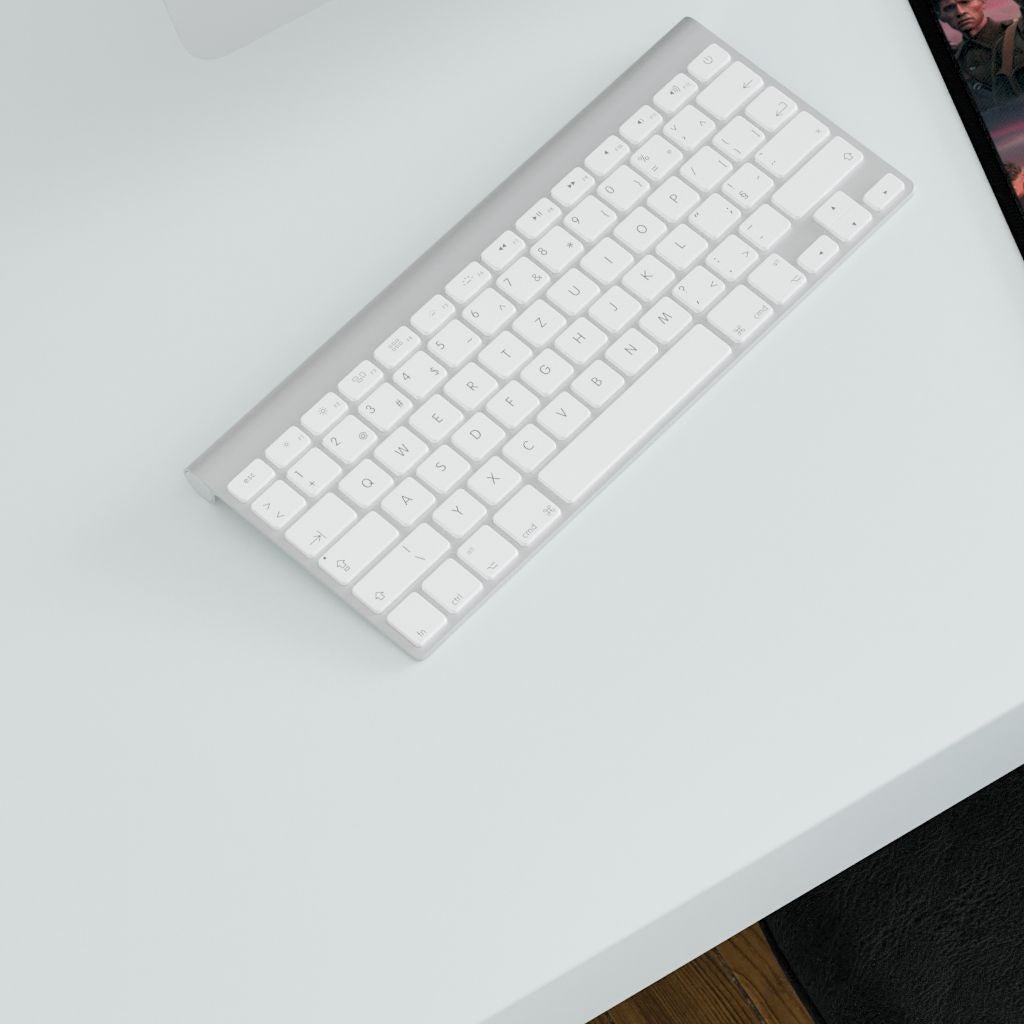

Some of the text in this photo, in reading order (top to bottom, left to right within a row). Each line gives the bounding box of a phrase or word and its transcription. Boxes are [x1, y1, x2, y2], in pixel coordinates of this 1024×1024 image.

[667, 192, 680, 204] P
[570, 215, 581, 225] 9
[634, 223, 649, 235] O
[673, 240, 687, 250] L
[536, 246, 549, 257] 8
[639, 269, 654, 281] K
[502, 277, 513, 287] 7
[567, 284, 582, 297] U
[607, 301, 619, 313] J
[753, 304, 770, 320] cmd
[468, 309, 481, 320] 6
[657, 311, 673, 326] M
[534, 315, 548, 329] Z
[571, 331, 587, 344] H
[434, 339, 447, 351] 5
[624, 343, 639, 355] N
[499, 347, 512, 359] T
[538, 363, 552, 377] G
[401, 370, 411, 383] 4
[590, 375, 604, 388] B
[465, 380, 480, 392] R
[504, 395, 516, 408] F
[364, 403, 376, 415] 3
[554, 407, 569, 419] V
[430, 412, 444, 424] E
[468, 428, 483, 441] D
[328, 436, 342, 447] 2
[521, 439, 535, 452] C
[393, 442, 410, 458] W
[434, 461, 448, 473] S
[360, 477, 375, 489] Q
[486, 471, 501, 487] X
[400, 494, 415, 507] A
[450, 503, 465, 517] Y
[521, 522, 539, 539] cmd
